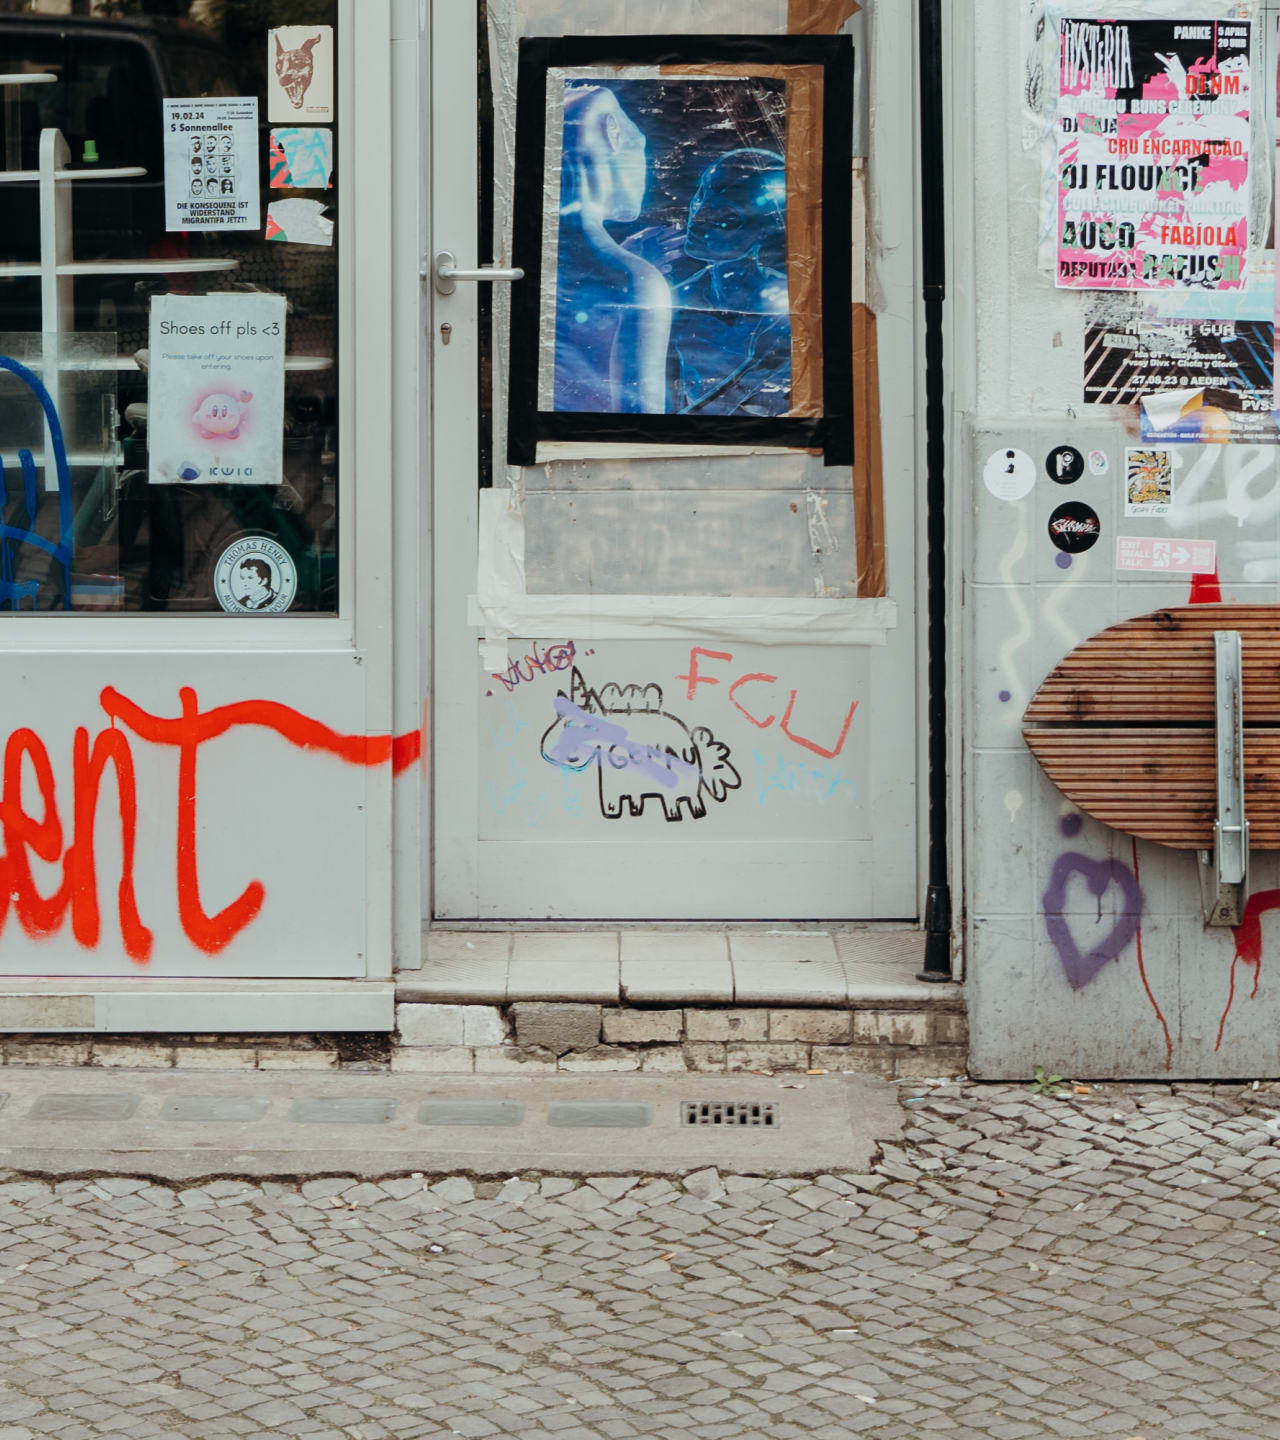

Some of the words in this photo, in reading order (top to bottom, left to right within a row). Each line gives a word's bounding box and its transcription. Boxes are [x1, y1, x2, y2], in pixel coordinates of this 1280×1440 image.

[1173, 26, 1211, 40] PANKE
[1224, 27, 1247, 37] APRIL
[172, 112, 205, 120] 19.02.24
[170, 123, 176, 132] S
[180, 122, 233, 132] Sonnenallee
[1108, 138, 1139, 154] CRU
[1062, 164, 1088, 190] DJ
[1096, 164, 1205, 192] FLOUNCE
[177, 202, 188, 210] DIE
[190, 201, 236, 210] KONSEQUENZ
[238, 201, 249, 209] IST
[189, 209, 236, 217] WIDERSTAND
[182, 216, 224, 224] MIGRANTIFA
[160, 321, 206, 336] Shoes
[210, 321, 232, 336] off
[236, 321, 258, 339] pls
[262, 322, 281, 336] <3
[215, 354, 233, 362] your
[1132, 375, 1178, 385] 27.08.23
[1190, 376, 1228, 386] AEDEN
[223, 541, 257, 566] THOMAS
[260, 542, 288, 566] HENRY
